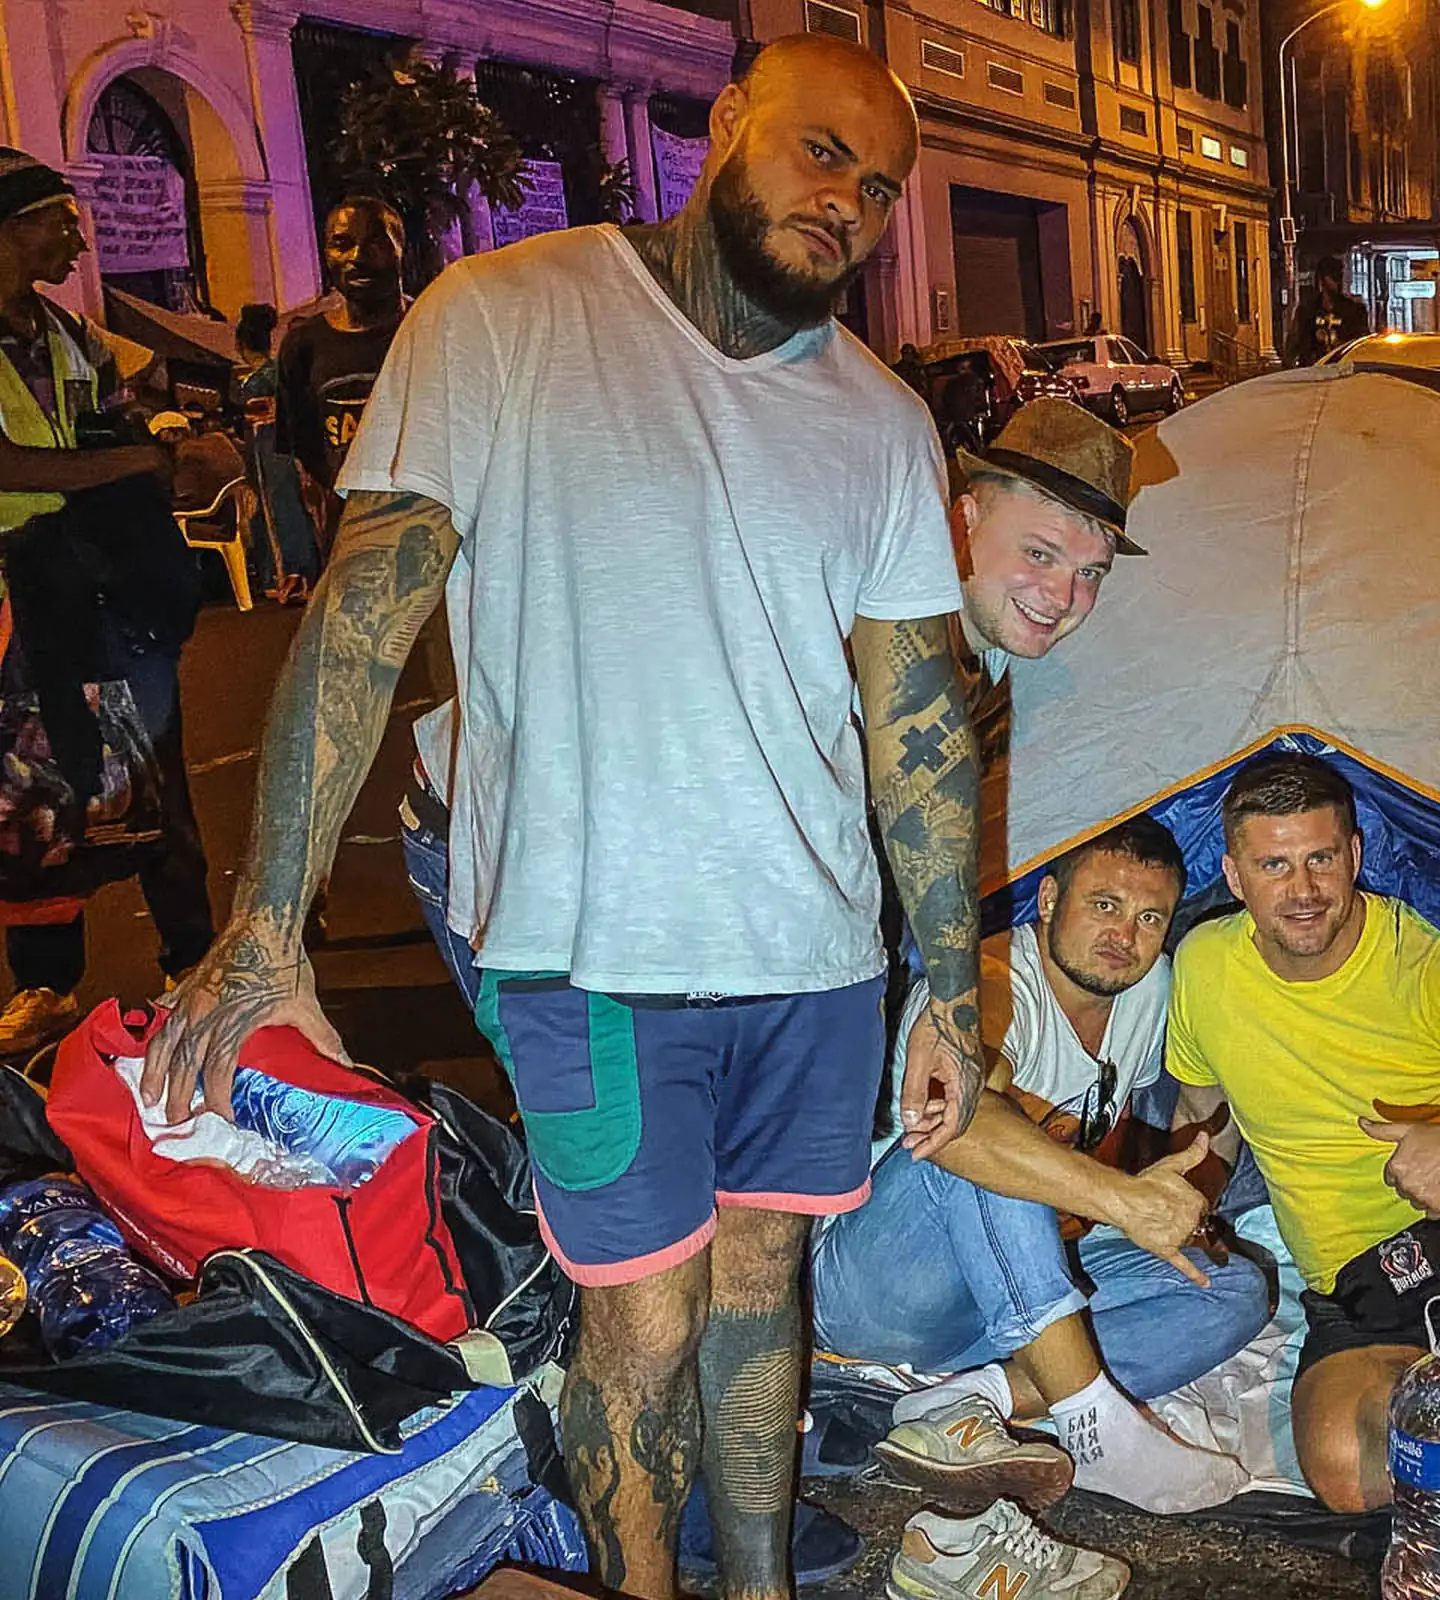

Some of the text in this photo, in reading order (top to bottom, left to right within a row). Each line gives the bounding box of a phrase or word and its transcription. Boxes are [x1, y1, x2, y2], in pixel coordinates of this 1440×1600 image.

[944, 1414, 997, 1449] N
[1068, 1406, 1097, 1433] БЛЯ
[1074, 1446, 1105, 1465] ЛЯ
[974, 1562, 1031, 1600] N
